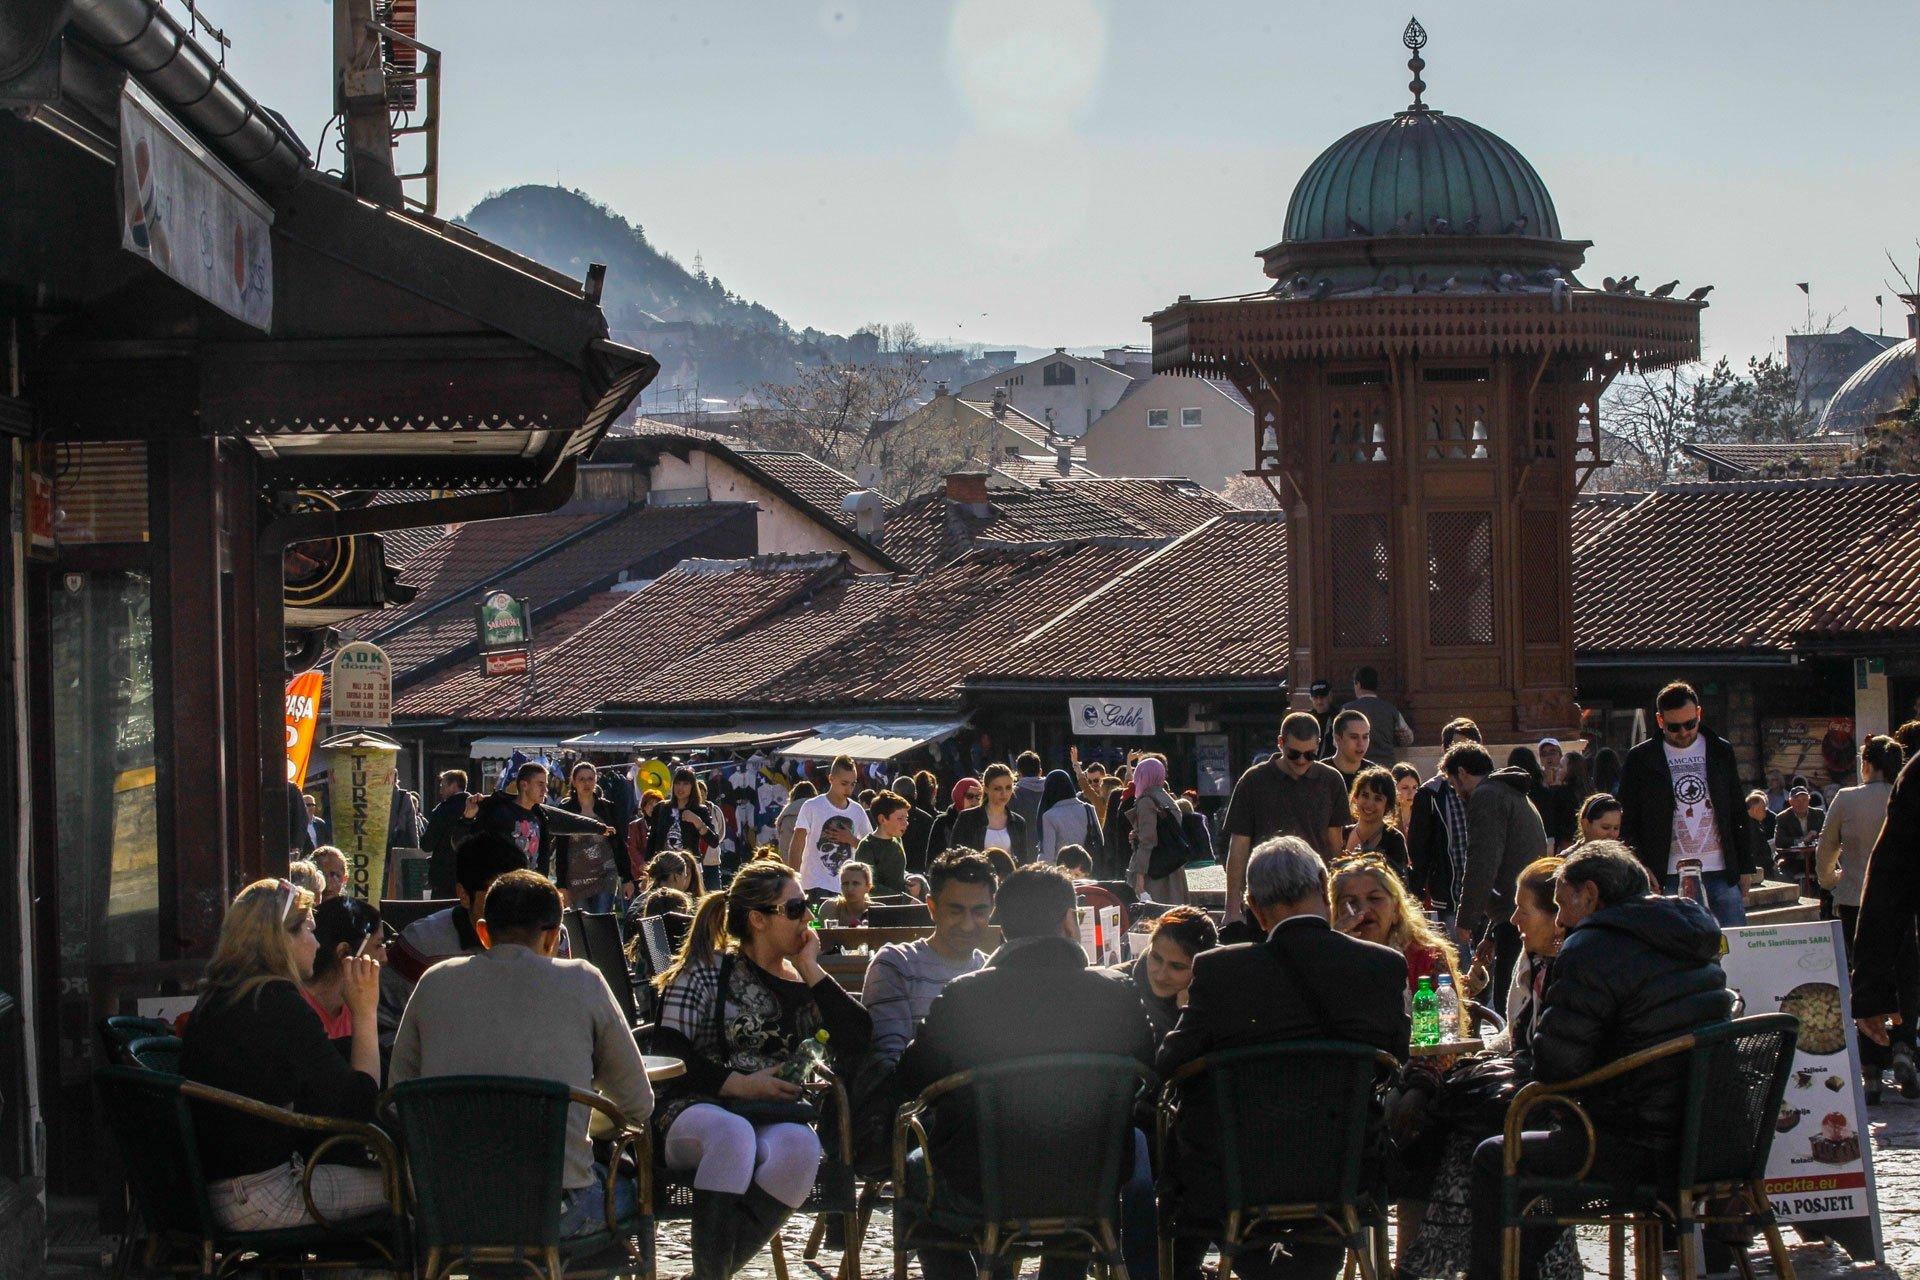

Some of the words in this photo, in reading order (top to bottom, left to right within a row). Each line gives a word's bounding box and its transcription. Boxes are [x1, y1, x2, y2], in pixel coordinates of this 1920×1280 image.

[353, 853, 370, 902] DON
[1765, 1178, 1837, 1194] cockta.eu
[1793, 1195, 1854, 1215] POSJETI
